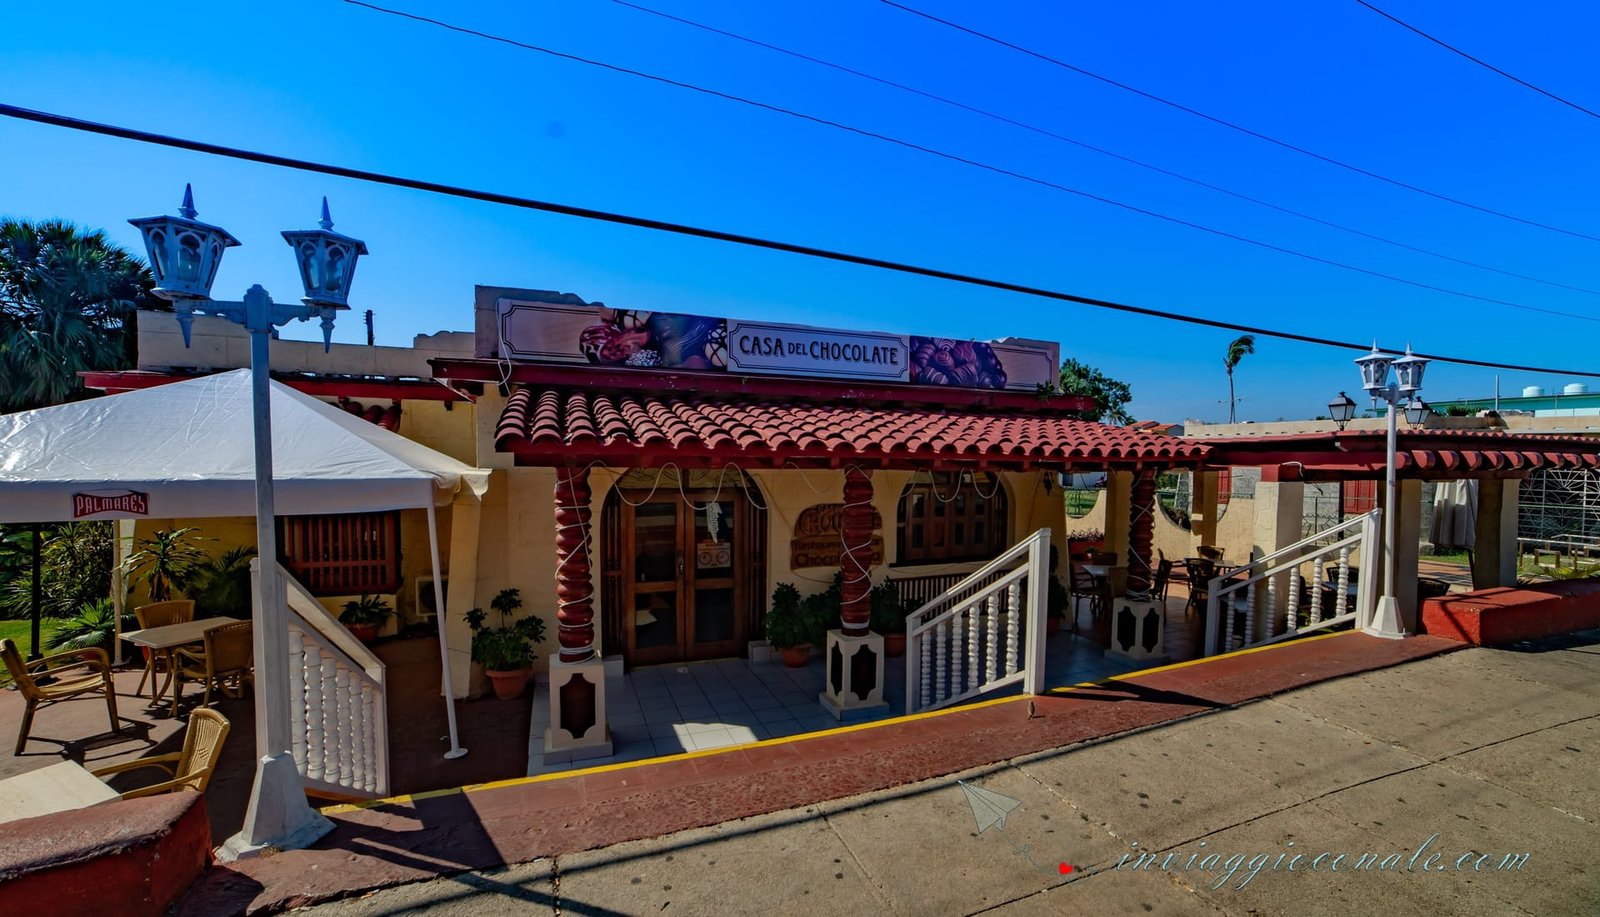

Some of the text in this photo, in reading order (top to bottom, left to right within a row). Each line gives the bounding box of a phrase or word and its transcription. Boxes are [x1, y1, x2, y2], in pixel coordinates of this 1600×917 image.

[739, 335, 899, 365] CASA DEL CHOCOLATE
[76, 494, 146, 516] PALMARES
